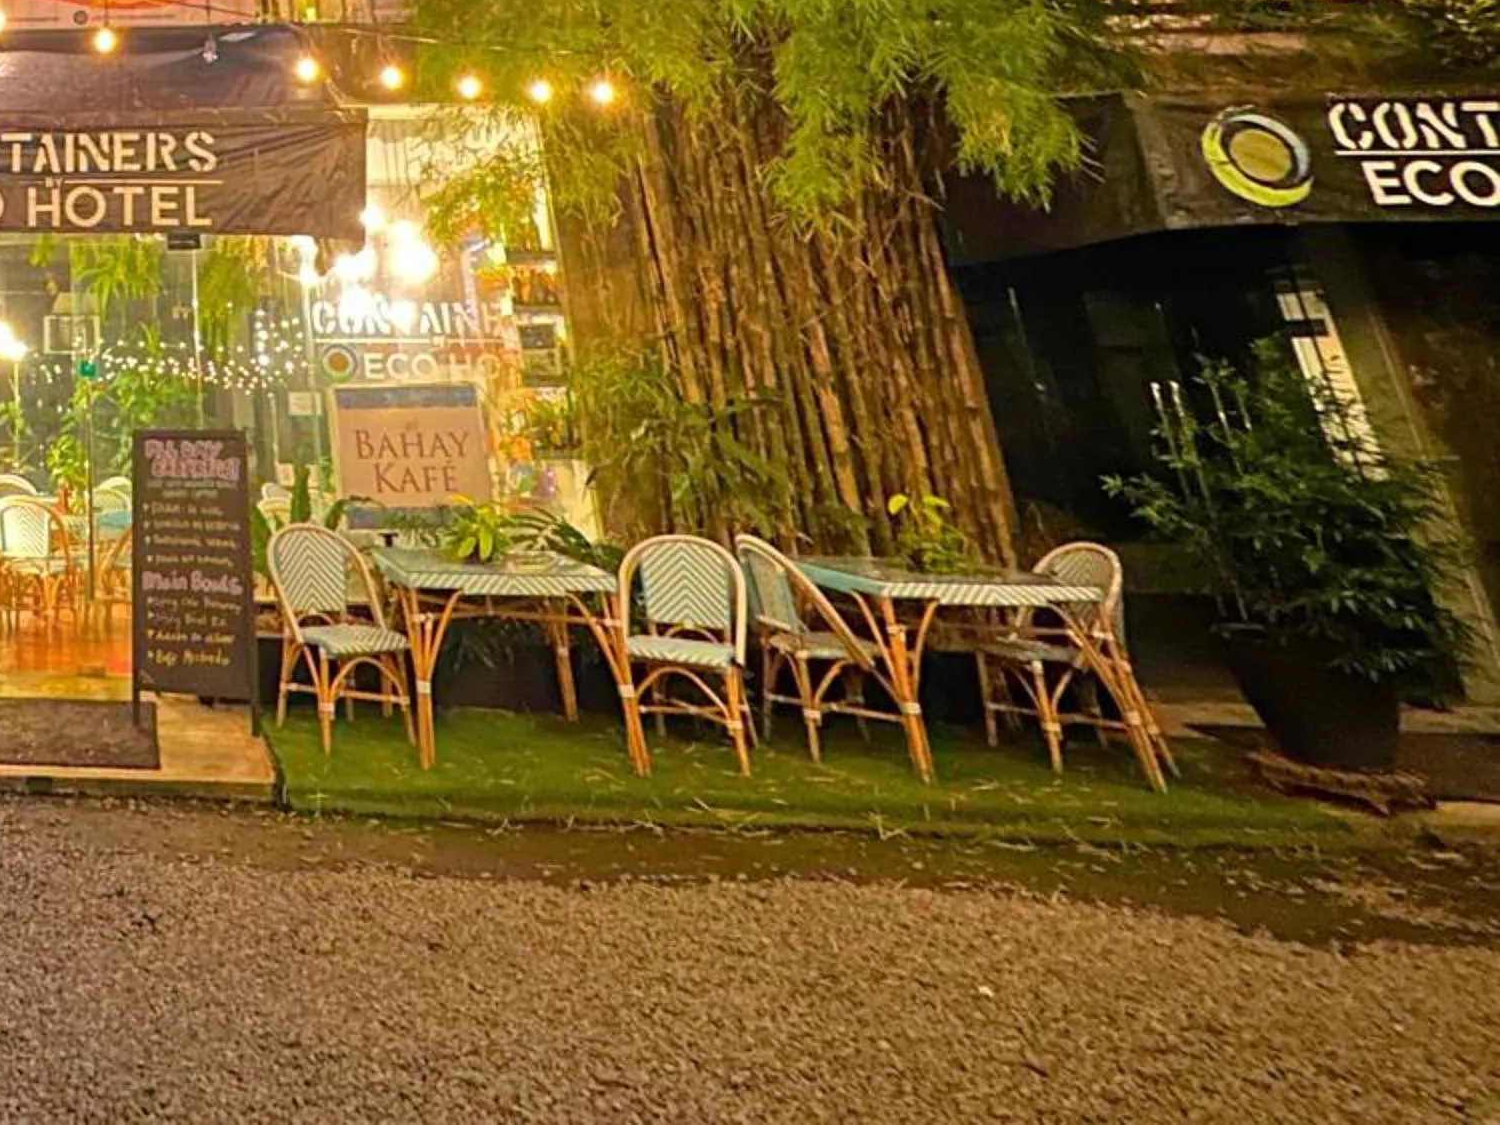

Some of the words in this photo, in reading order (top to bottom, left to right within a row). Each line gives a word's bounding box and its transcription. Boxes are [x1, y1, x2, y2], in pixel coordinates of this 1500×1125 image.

[1327, 101, 1500, 150] CONT
[1360, 159, 1500, 207] ECO
[27, 185, 213, 227] HOTEL
[364, 352, 436, 379] ECO
[354, 428, 469, 460] BAHAY
